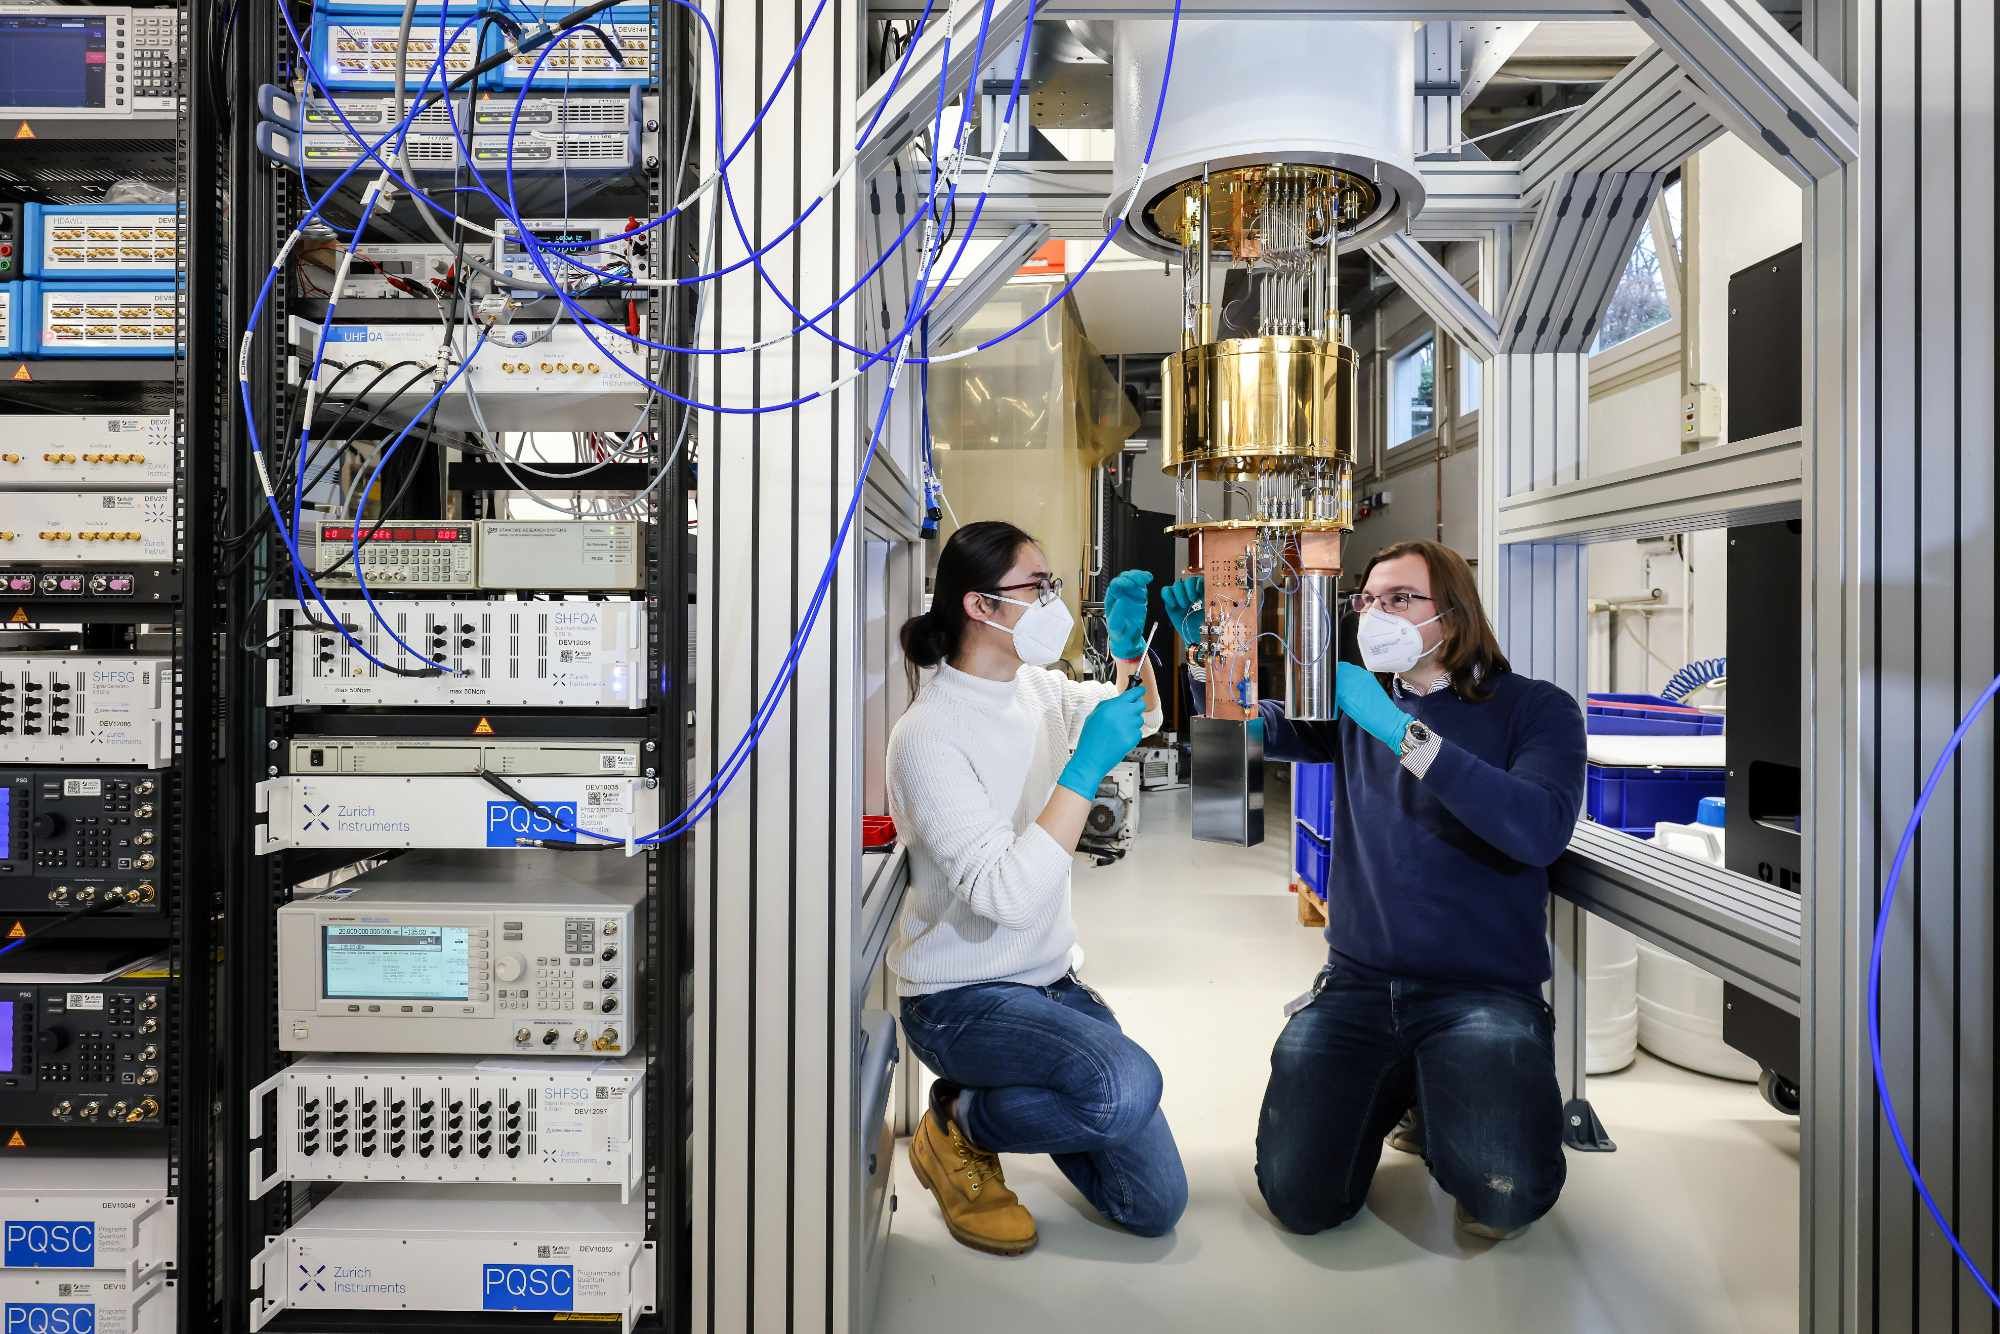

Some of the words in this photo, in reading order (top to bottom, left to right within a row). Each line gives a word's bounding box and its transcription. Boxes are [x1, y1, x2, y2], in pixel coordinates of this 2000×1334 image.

[338, 806, 376, 817] Zurich
[490, 805, 574, 833] PQSC
[338, 821, 410, 832] Instruments
[544, 1088, 590, 1100] SHFSG
[8, 1225, 92, 1253] PQSC
[334, 1266, 372, 1278] Zurich
[334, 1282, 406, 1294] Instruments
[486, 1268, 571, 1296] PQSC
[8, 1307, 92, 1334] PQSC
